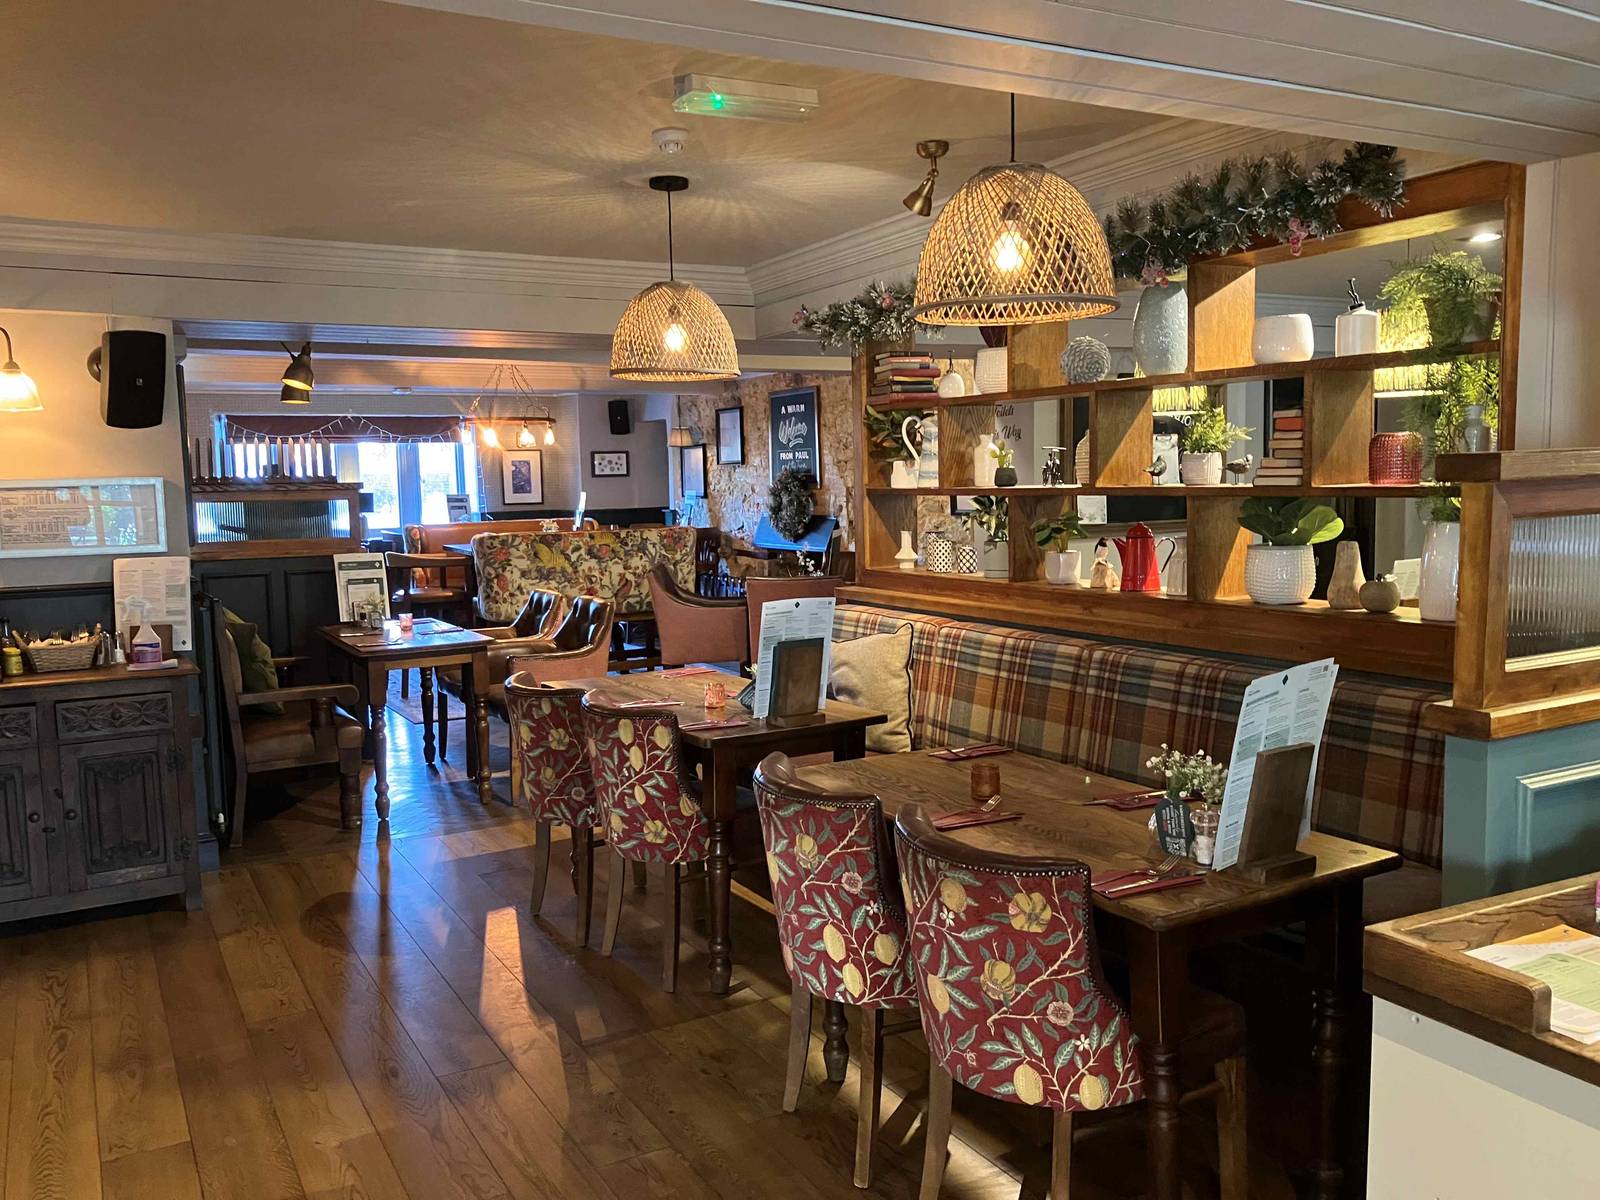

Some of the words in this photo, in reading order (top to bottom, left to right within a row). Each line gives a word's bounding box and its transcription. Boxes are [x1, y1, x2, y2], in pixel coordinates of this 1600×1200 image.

[787, 404, 805, 413] WARM
[995, 404, 1014, 417] Toilets
[1001, 424, 1022, 441] Way
[780, 452, 793, 460] FROM
[795, 451, 809, 459] PAUL
